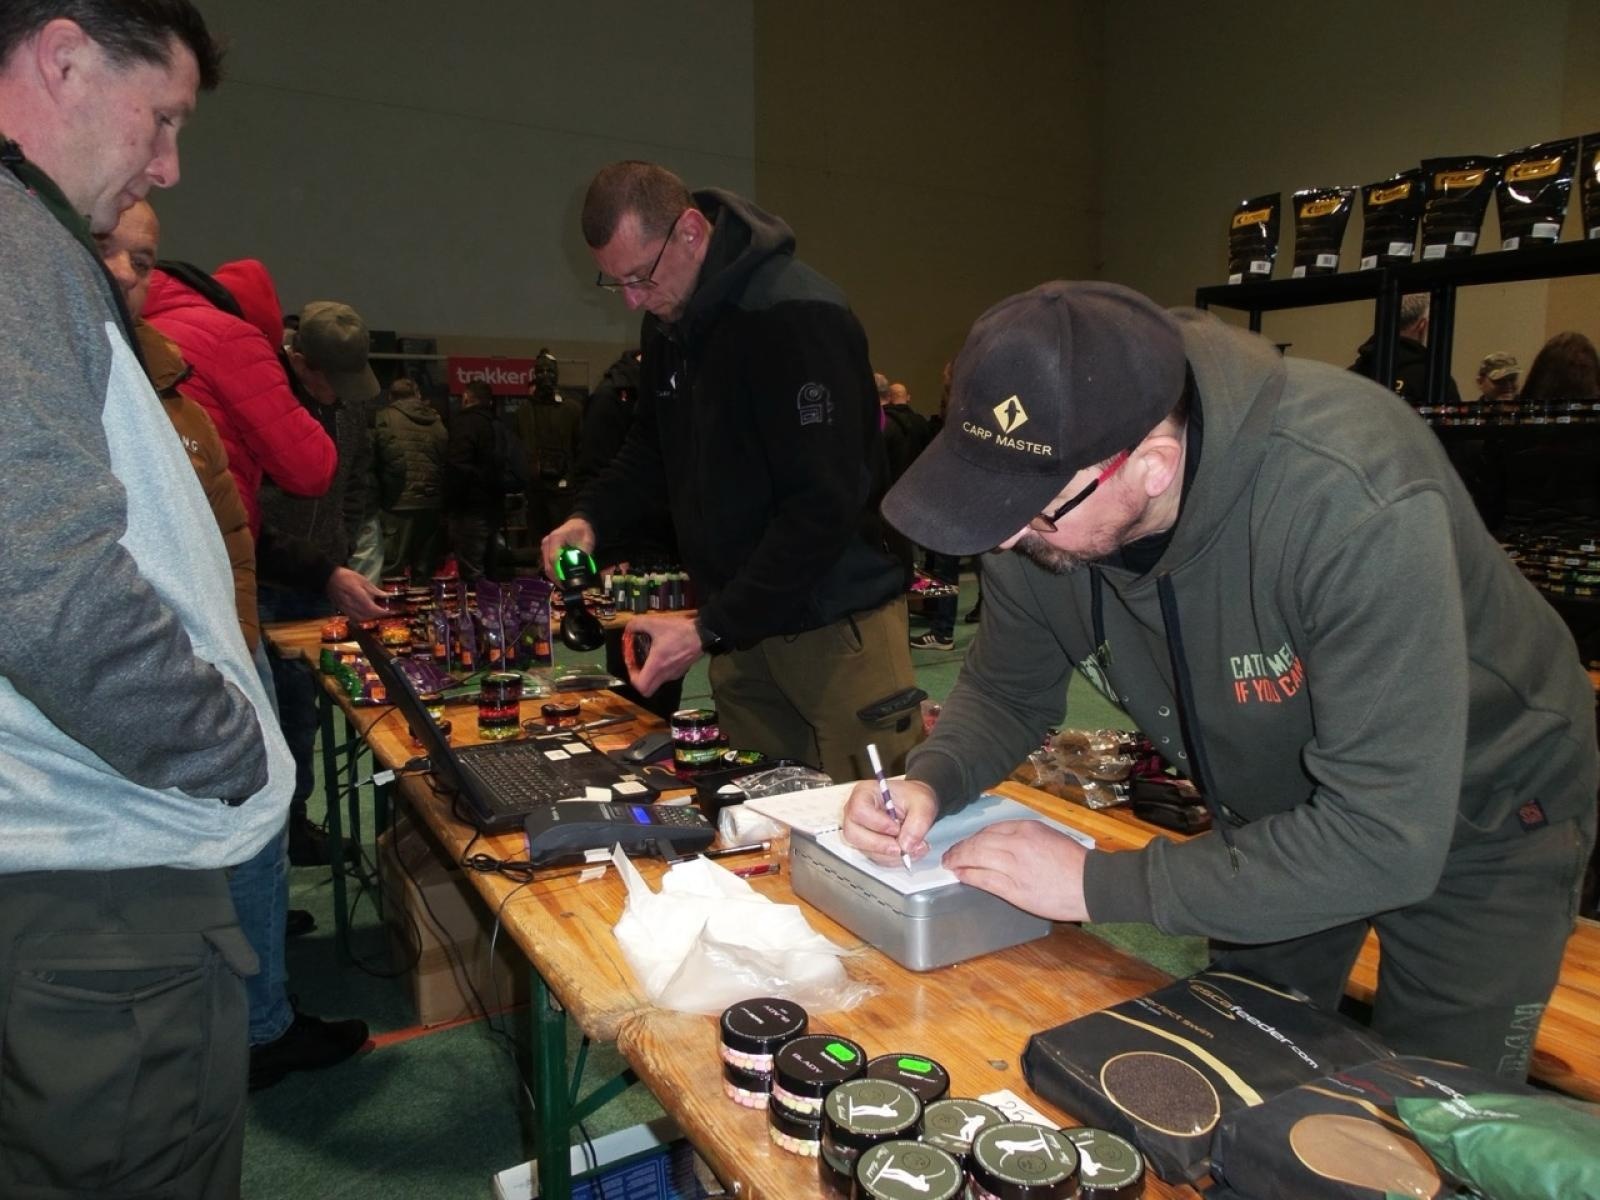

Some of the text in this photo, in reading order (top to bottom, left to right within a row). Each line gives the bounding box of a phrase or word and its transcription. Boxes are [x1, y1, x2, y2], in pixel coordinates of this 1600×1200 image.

[456, 366, 527, 385] trakker
[963, 422, 1052, 456] CARP MASTER
[1234, 681, 1249, 703] IF
